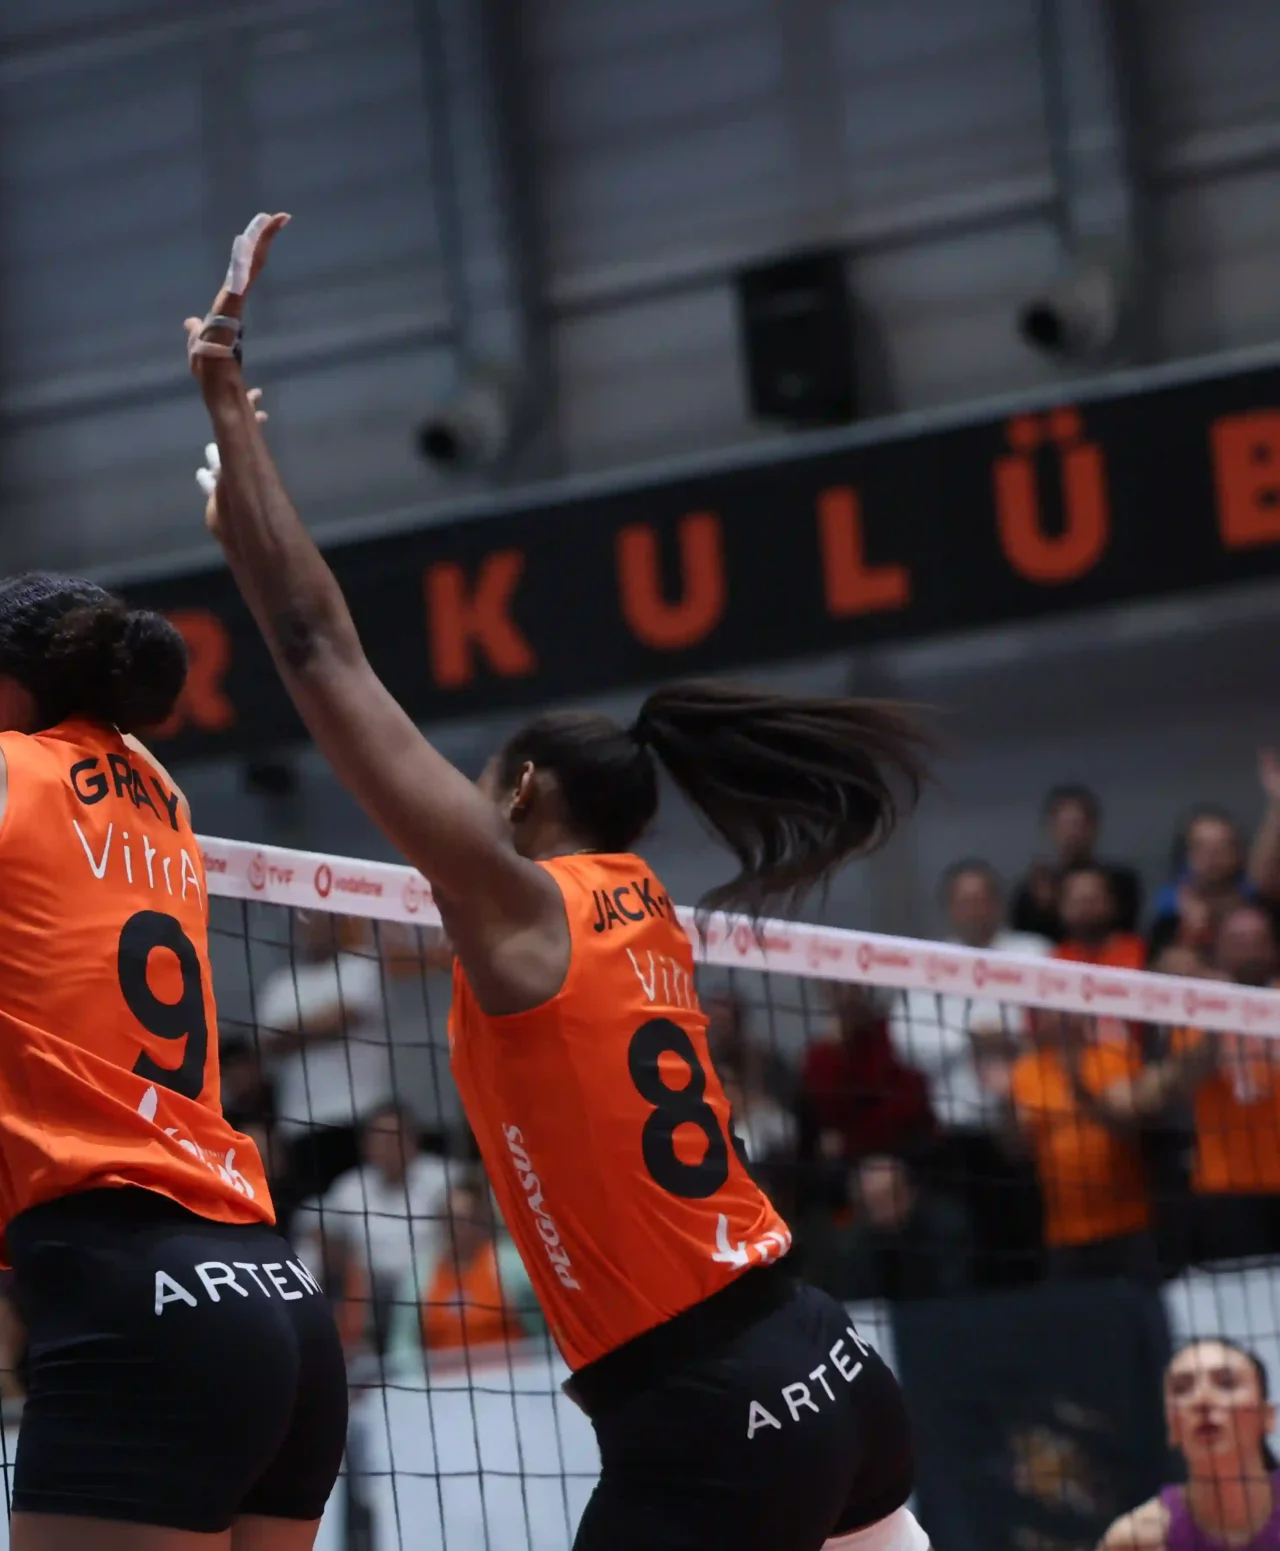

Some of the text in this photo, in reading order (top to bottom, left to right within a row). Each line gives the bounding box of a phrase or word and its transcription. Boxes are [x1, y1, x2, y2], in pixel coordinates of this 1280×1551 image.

[69, 752, 180, 832] GRAY
[72, 818, 203, 912] VitrA
[117, 910, 209, 1100] 9
[627, 1017, 730, 1199] 8
[502, 1123, 581, 1290] PEGASUS
